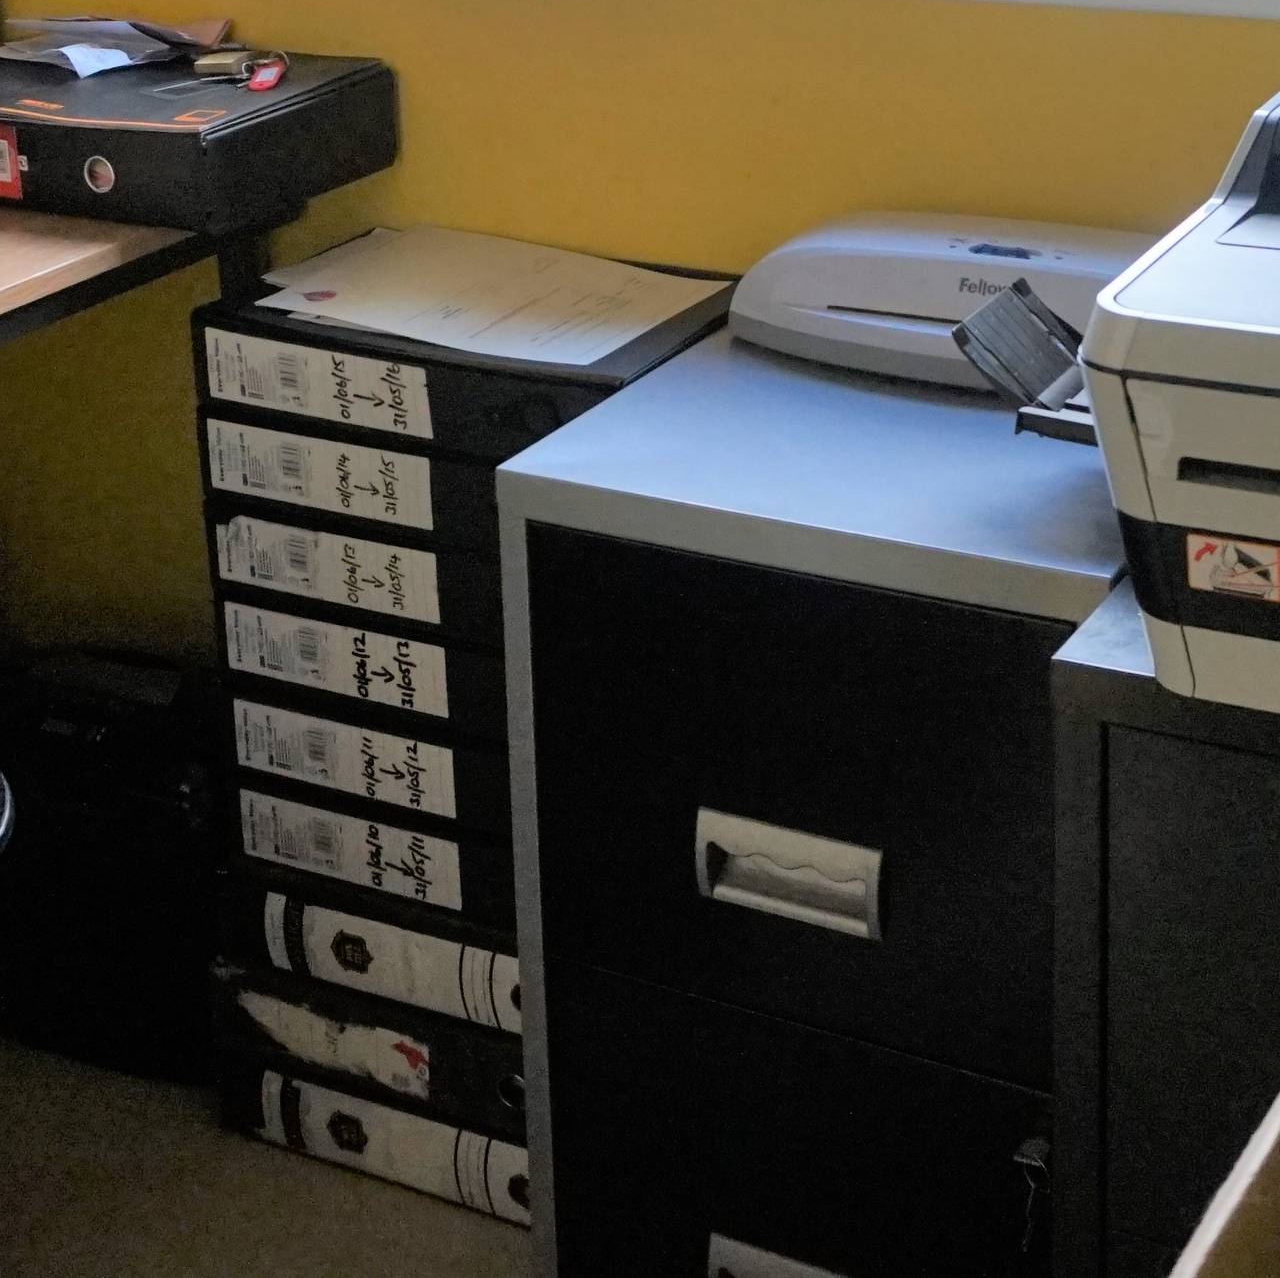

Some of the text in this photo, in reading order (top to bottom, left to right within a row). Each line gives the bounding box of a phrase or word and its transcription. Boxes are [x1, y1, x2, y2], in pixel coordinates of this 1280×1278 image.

[331, 354, 355, 420] 01/06/15
[380, 362, 409, 431] 31/05/16
[335, 452, 354, 508] 01/06/14
[378, 455, 400, 516] 31/05/15
[341, 543, 365, 605] 01/06/13
[384, 553, 407, 611] 31/05/14
[392, 640, 418, 709] 31/05/13
[360, 736, 382, 801] 01/06/11
[402, 741, 427, 808] 31/05/12
[407, 834, 433, 900] 31/05/11
